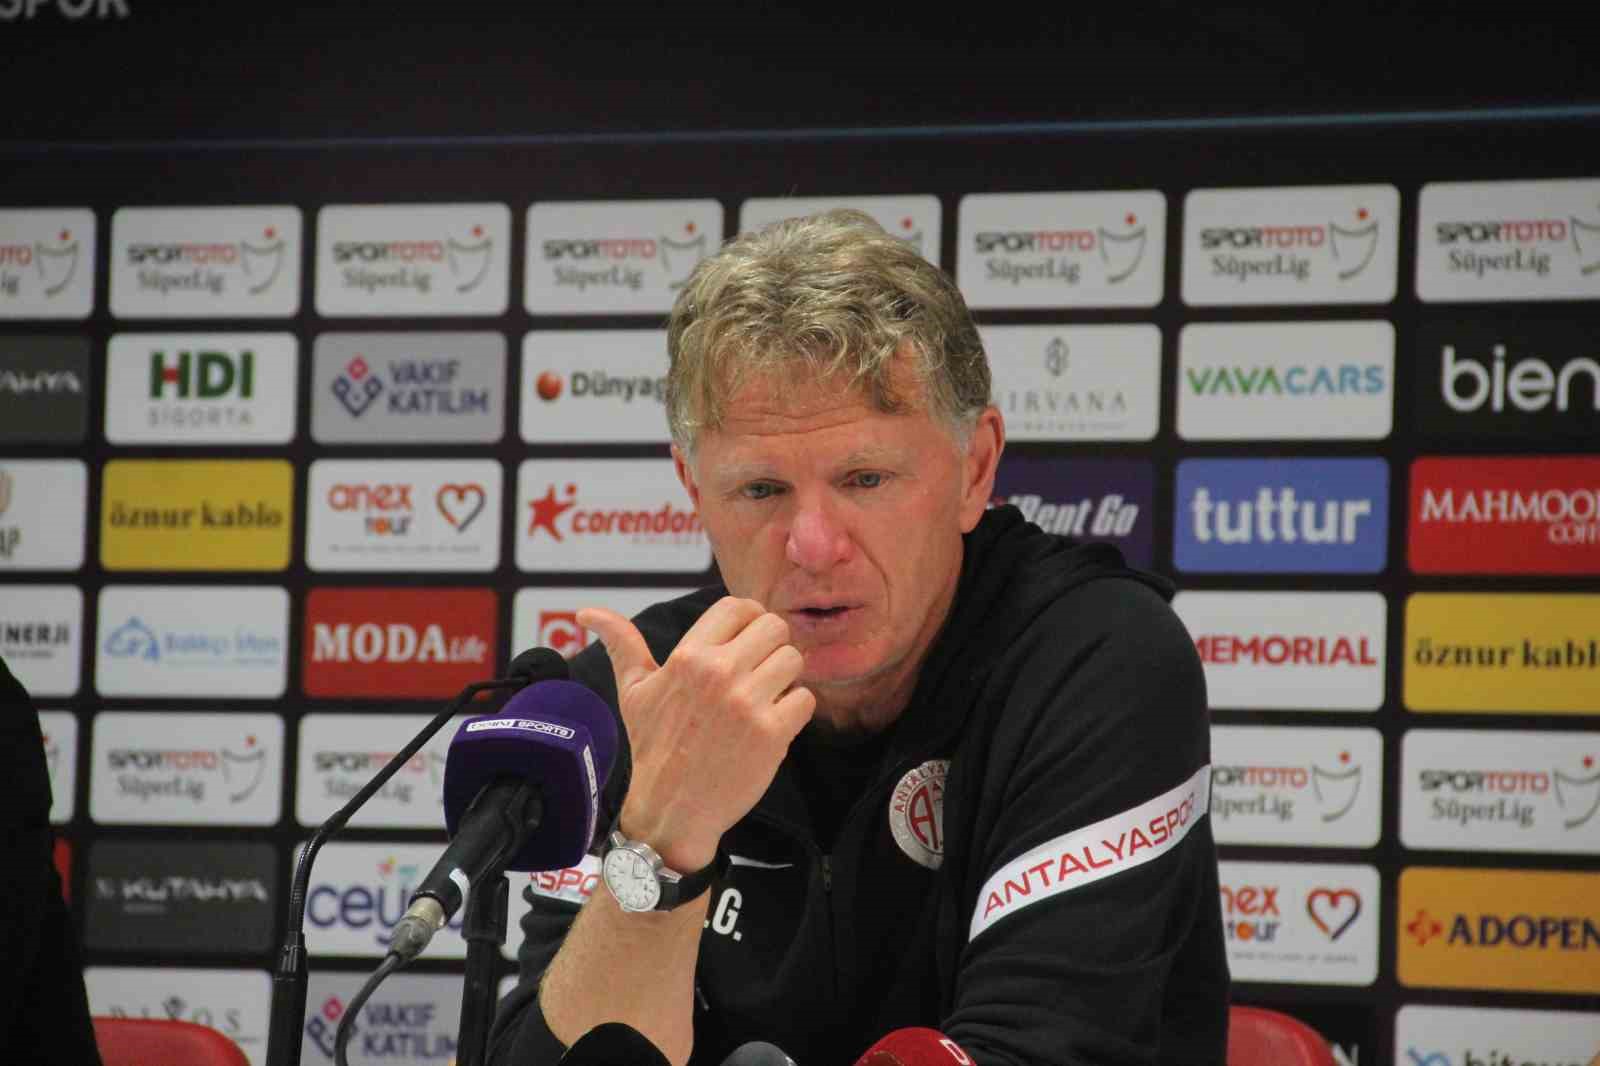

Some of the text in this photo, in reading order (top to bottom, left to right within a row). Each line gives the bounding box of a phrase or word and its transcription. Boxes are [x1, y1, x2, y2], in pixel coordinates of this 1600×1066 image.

[975, 229, 1095, 254] SPORTOTO
[1200, 225, 1325, 250] SPORTOTO
[1437, 219, 1567, 245] SPORTOTO
[128, 243, 239, 265] SPORTOTO
[333, 241, 444, 263] SPORTOTO
[543, 239, 656, 259] SPORTOTO
[149, 350, 254, 400] HDI
[388, 360, 459, 384] VAKIF
[1187, 365, 1385, 396] VAVACARS
[1441, 345, 1600, 413] bien
[387, 388, 489, 415] KATILIM
[996, 390, 1127, 413] IRVANA
[327, 483, 412, 512] anex
[110, 502, 283, 528] öznur kablo
[365, 516, 412, 536] tour
[1091, 494, 1139, 536] Go
[1192, 487, 1371, 544] tuttur
[1414, 638, 1600, 669] öznur kabl
[517, 720, 570, 737] SPORTS
[108, 749, 217, 769] SPORTOTO
[1212, 767, 1309, 788] ORTOTO
[1419, 771, 1549, 793] SPORTOTO
[1221, 886, 1280, 915] nex
[703, 887, 742, 940] .G.
[366, 1003, 435, 1026] VAKIF
